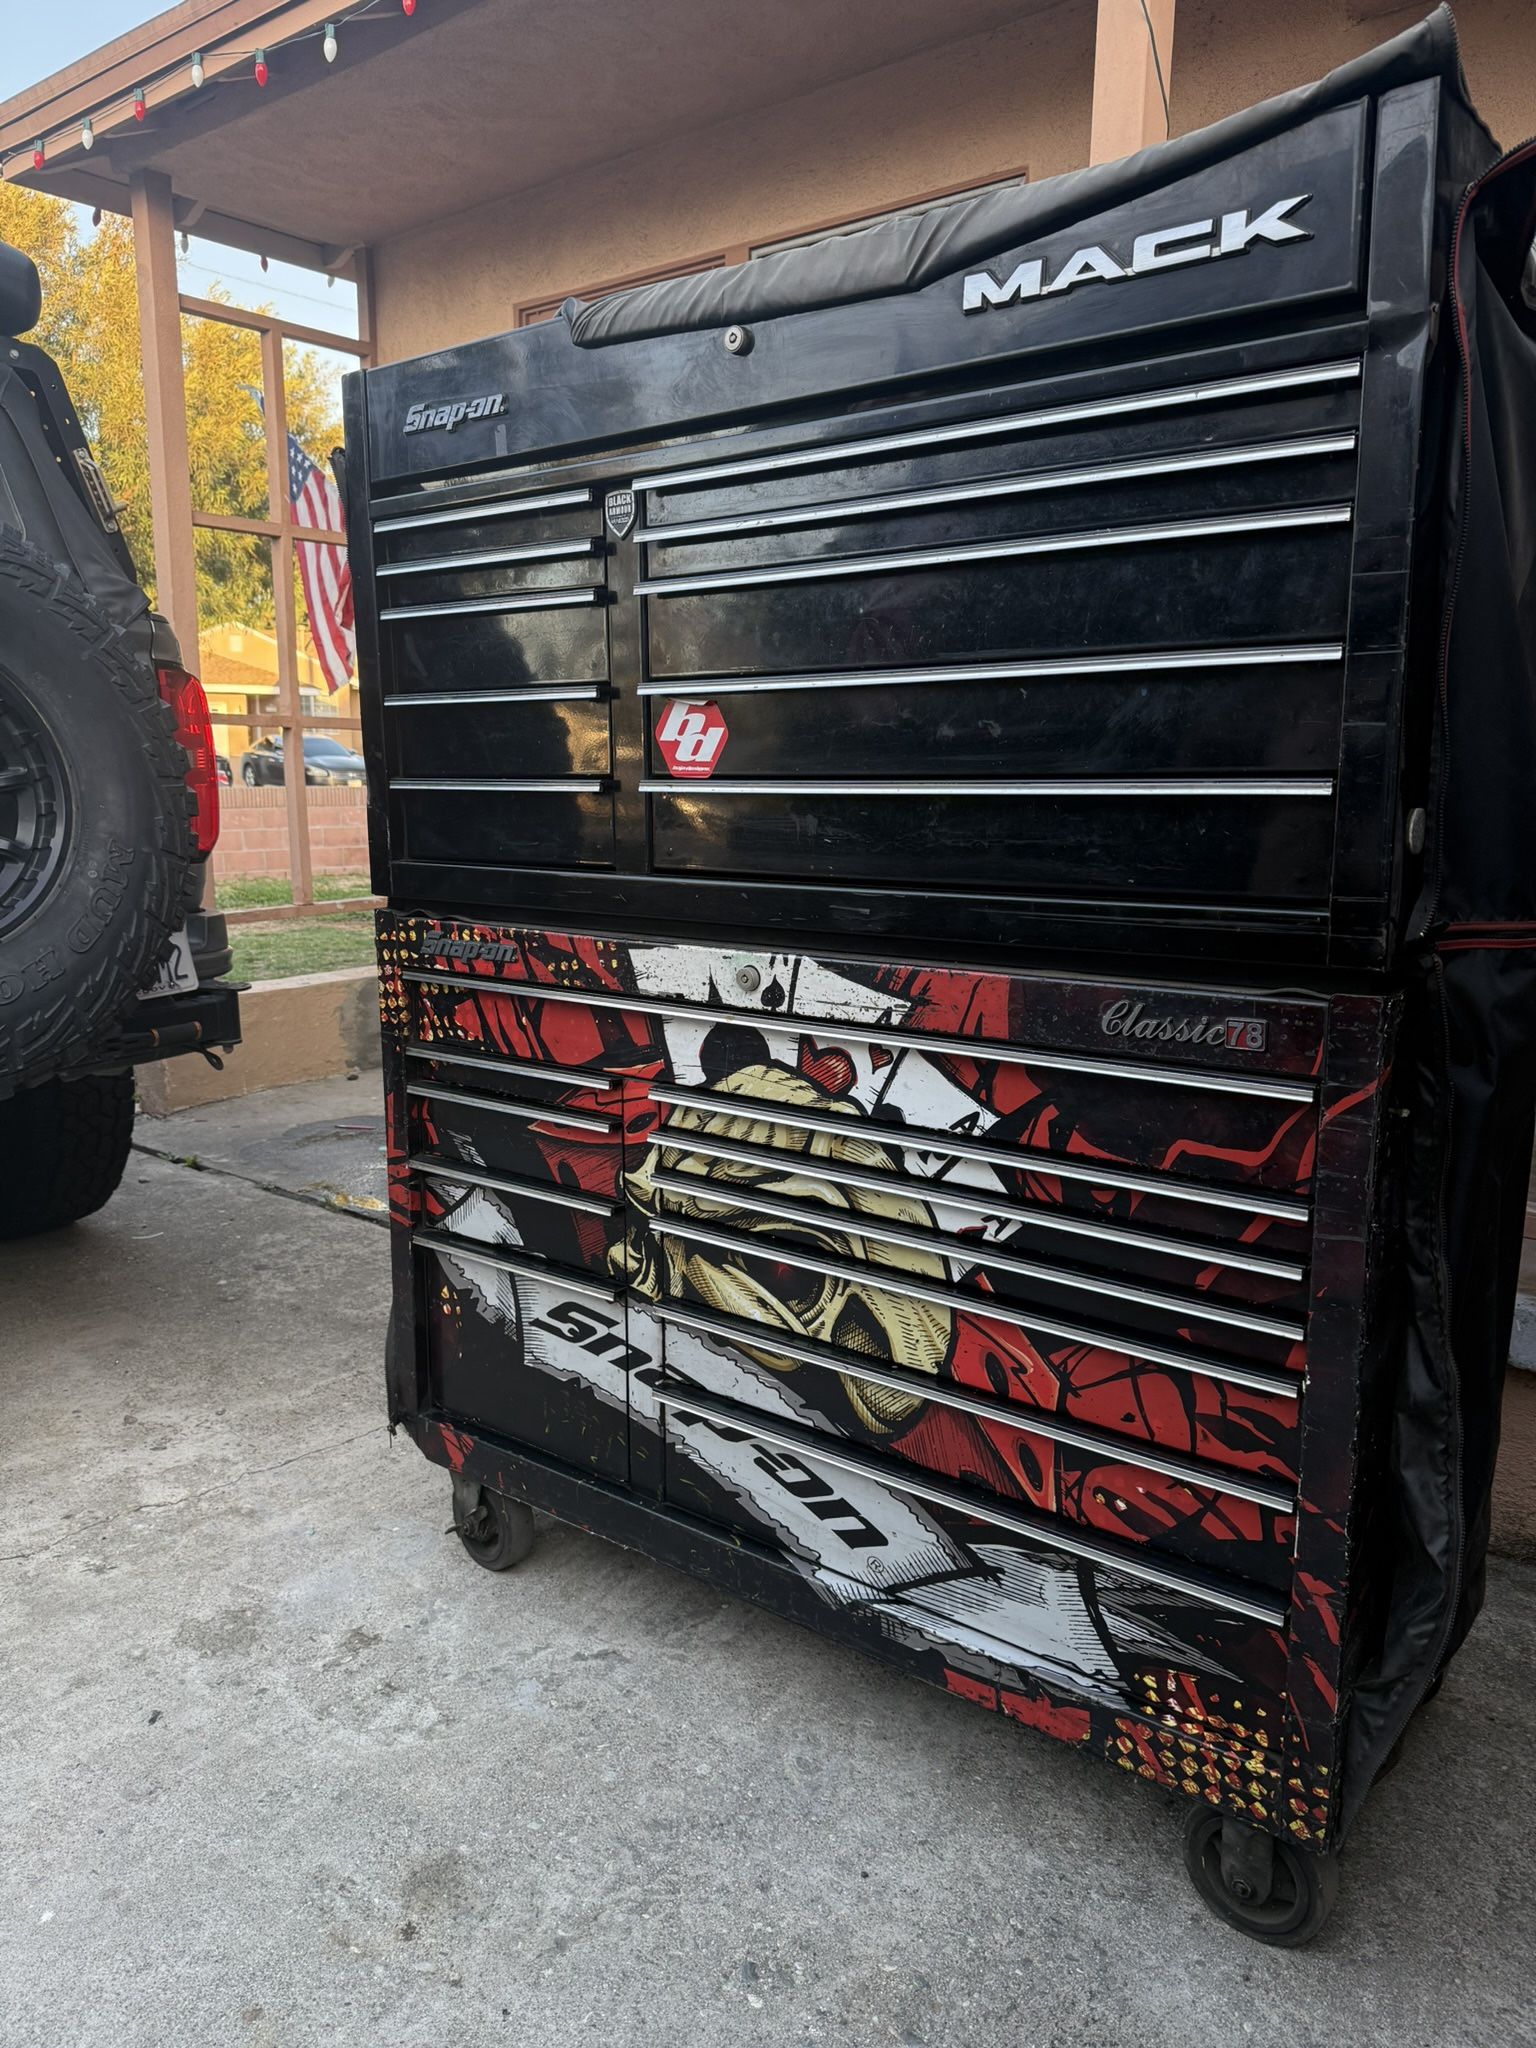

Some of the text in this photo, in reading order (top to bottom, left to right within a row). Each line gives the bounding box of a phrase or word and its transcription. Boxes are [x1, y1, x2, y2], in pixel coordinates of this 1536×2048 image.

[963, 193, 1312, 312] MACK
[403, 393, 505, 432] Snap-on
[608, 493, 631, 507] BLACK
[65, 838, 136, 954] MUD
[421, 930, 517, 962] Snap-on
[1101, 1000, 1263, 1049] Classic 78
